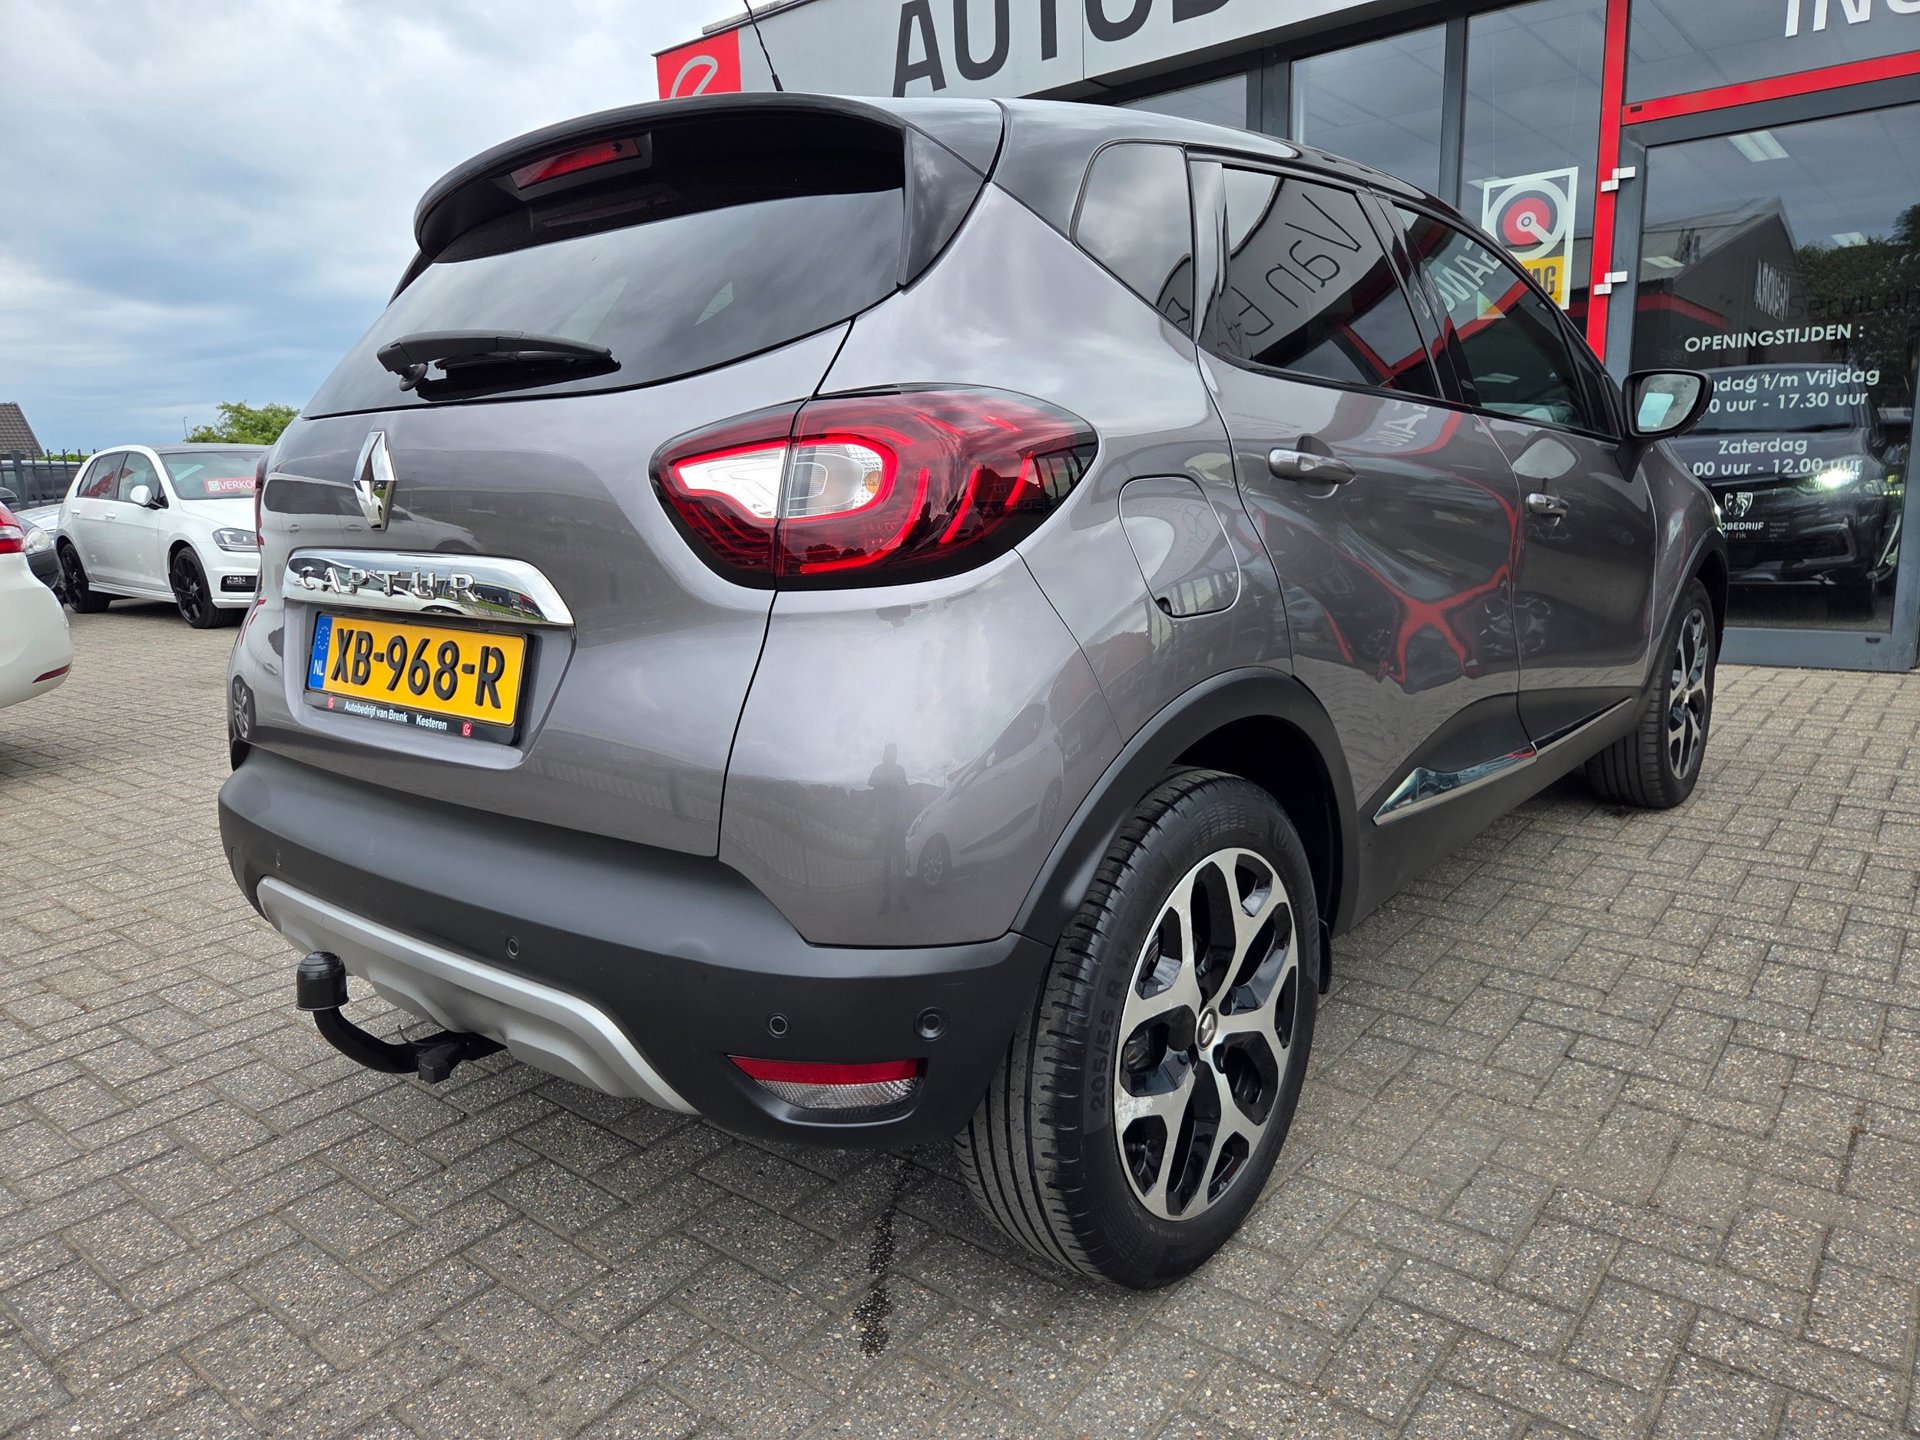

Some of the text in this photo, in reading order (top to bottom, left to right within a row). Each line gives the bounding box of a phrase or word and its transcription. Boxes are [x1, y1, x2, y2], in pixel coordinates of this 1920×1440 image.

[1528, 266, 1557, 295] AG
[1684, 323, 1852, 353] OPENINGSTIJDEN
[1763, 373, 1799, 390] t/m
[1806, 368, 1880, 388] Vrijdag
[1726, 399, 1757, 412] uur
[1778, 392, 1829, 409] 17.30
[1835, 392, 1869, 406] uur
[1718, 437, 1808, 455] Zaterdag
[1721, 463, 1751, 476] uur
[1773, 457, 1823, 473] 12.00
[1830, 459, 1863, 474] uur
[300, 566, 478, 602] CAPTUR
[313, 659, 324, 677] NL
[331, 628, 505, 709] XB-968-R
[344, 700, 447, 731] Autobedrijf van Brenk Kesteren
[1090, 1009, 1116, 1113] 205/55
